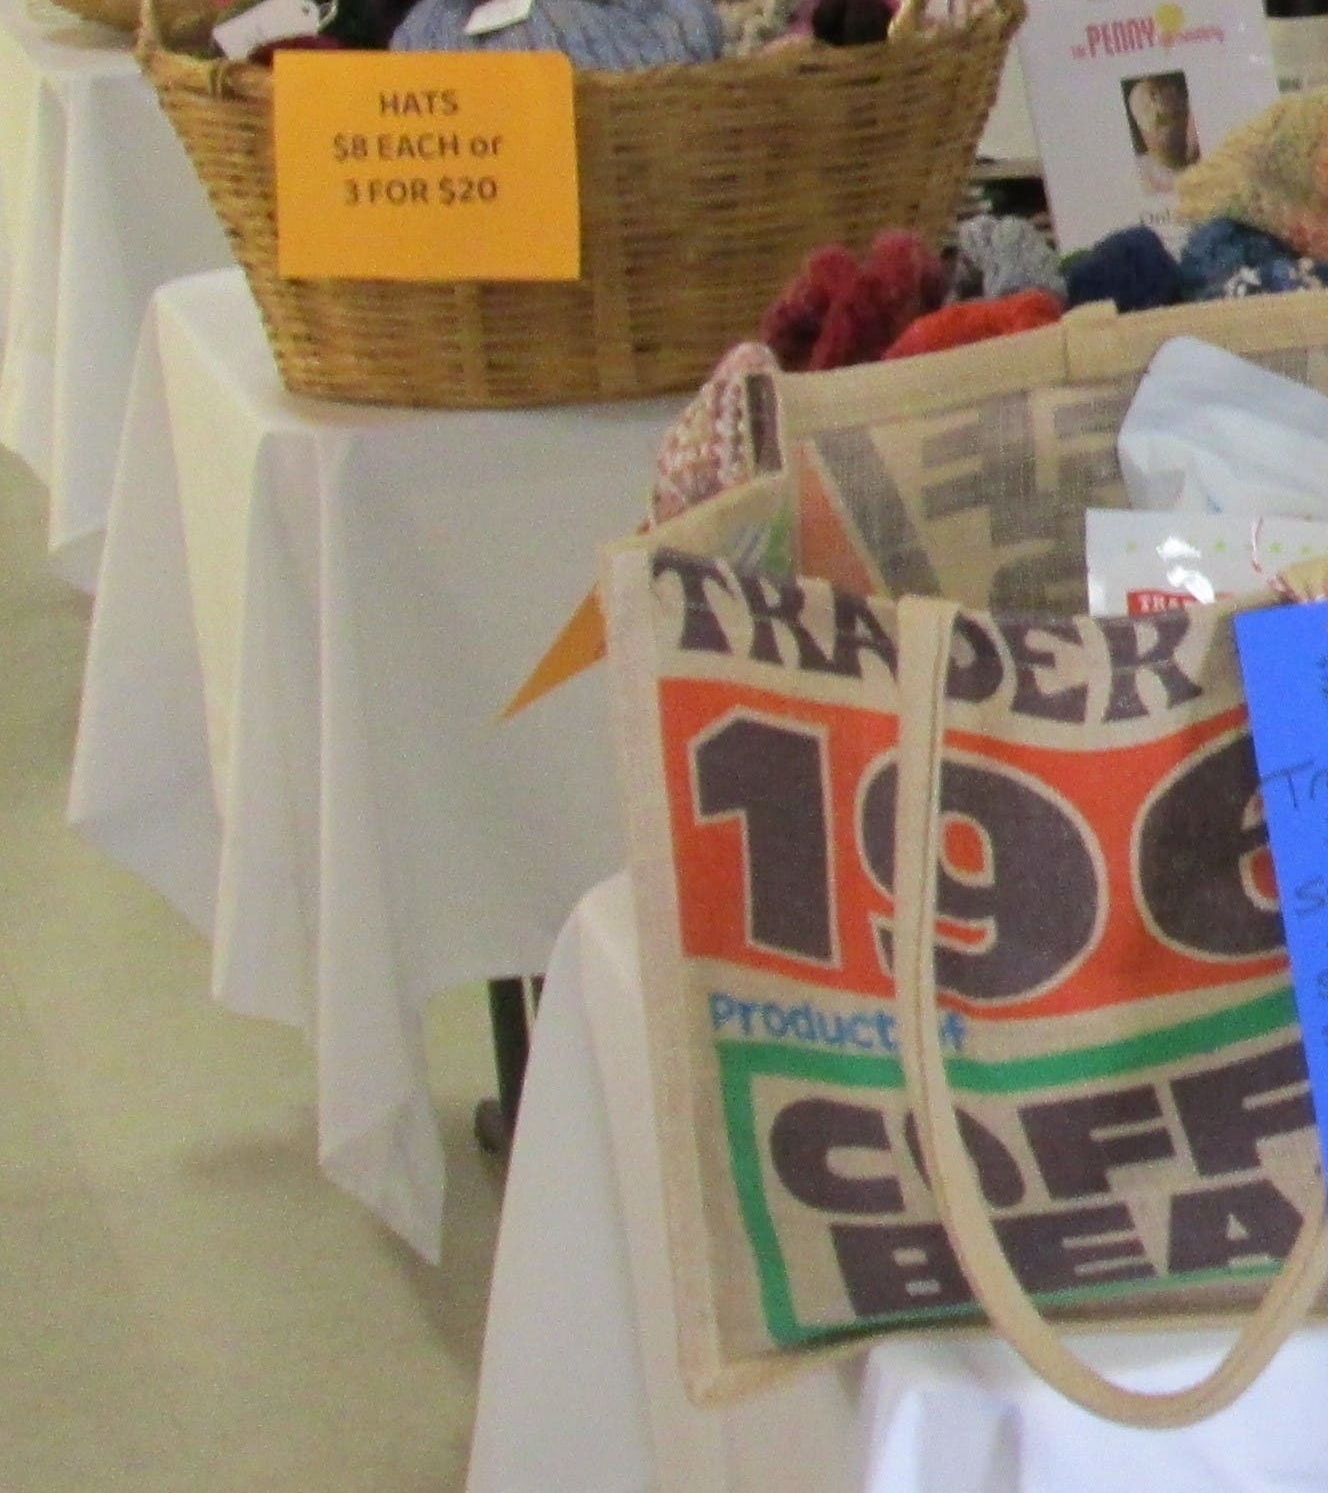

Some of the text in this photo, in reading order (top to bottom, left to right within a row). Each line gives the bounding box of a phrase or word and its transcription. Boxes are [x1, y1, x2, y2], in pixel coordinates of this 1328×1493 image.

[380, 89, 459, 117] HATS
[333, 132, 503, 162] $8 EACH or
[344, 176, 498, 206] 3 FOR $20
[1138, 208, 1170, 226] Onl
